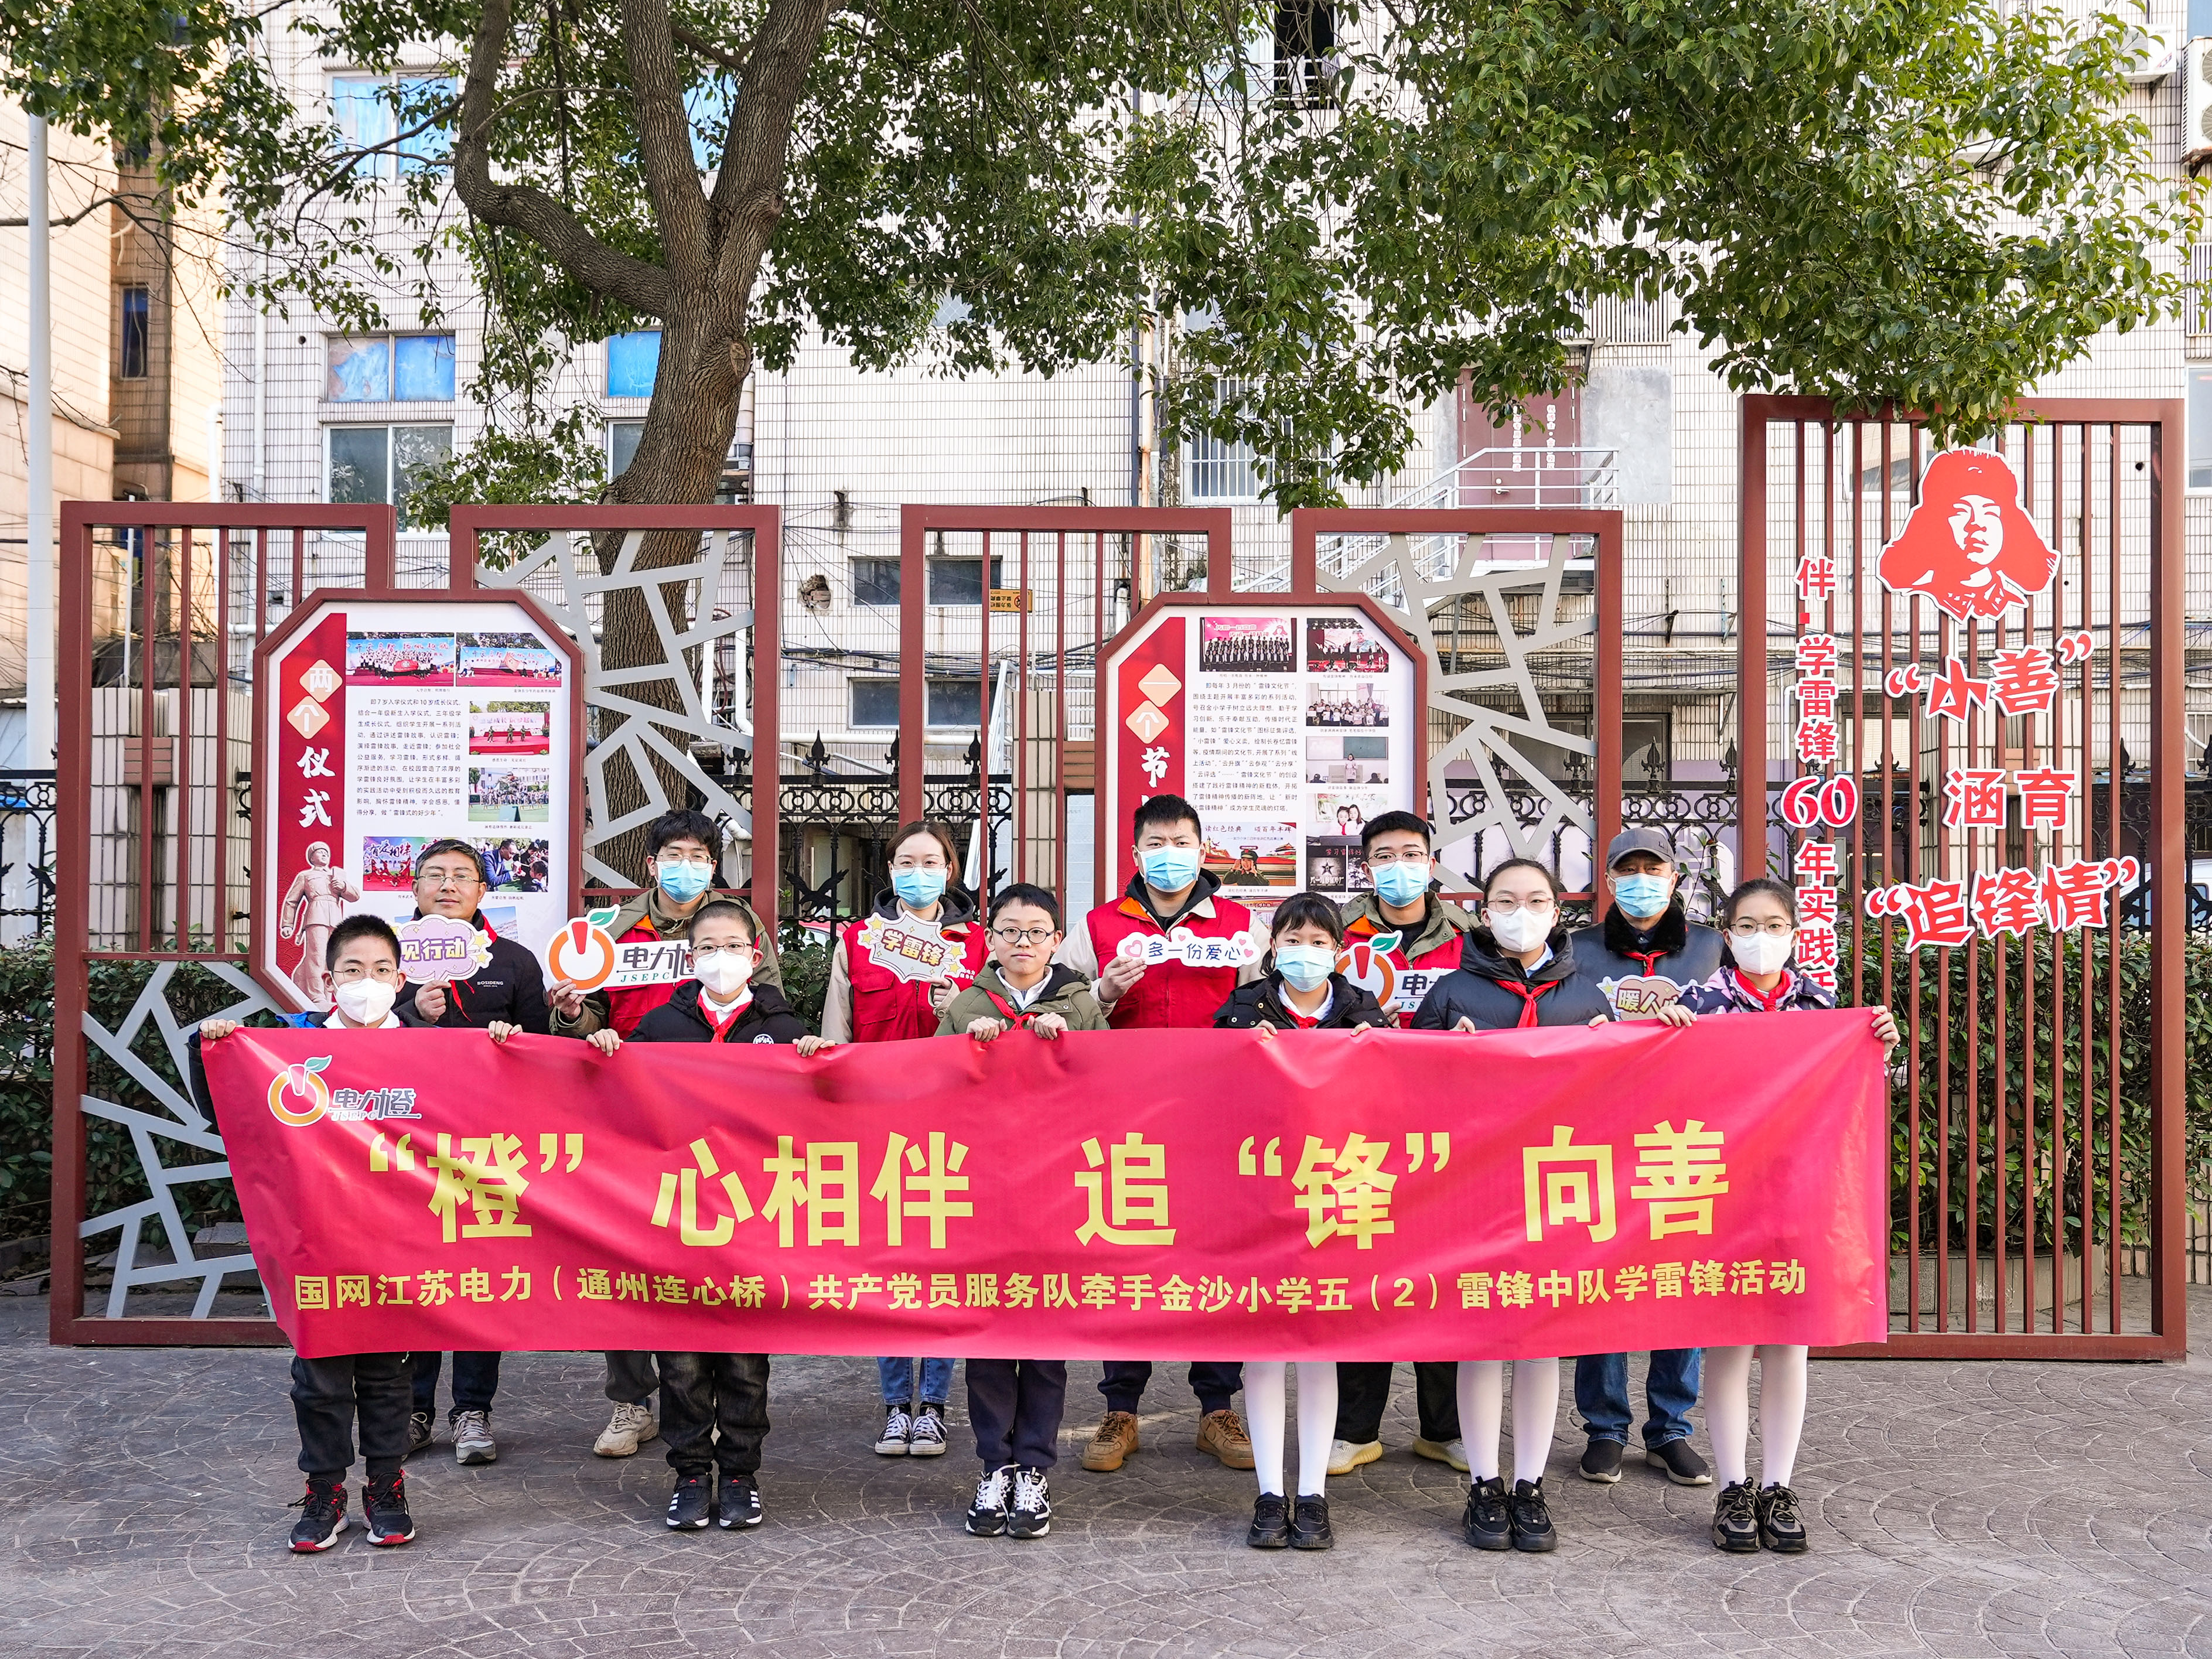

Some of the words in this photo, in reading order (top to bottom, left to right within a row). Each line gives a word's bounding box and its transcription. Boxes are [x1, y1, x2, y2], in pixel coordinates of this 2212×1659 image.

[1886, 631, 2092, 722] “小善”
[293, 667, 336, 828] 两个仪式
[1135, 682, 1177, 806] 一个节
[1943, 769, 2077, 828] 涵育
[1868, 856, 2138, 951] “追锋情”
[620, 972, 670, 983] JSEPC
[881, 928, 945, 968] 学雷锋
[1148, 941, 1241, 961] 多一份爱心
[1616, 988, 1679, 1014] 暖人
[332, 1111, 377, 1121] JSEPC
[370, 1133, 583, 1243] “橙”
[651, 1131, 973, 1249] 心相伴
[1074, 1132, 1176, 1247] 追
[1238, 1132, 1450, 1250] “锋”
[1522, 1119, 1730, 1242] 向善
